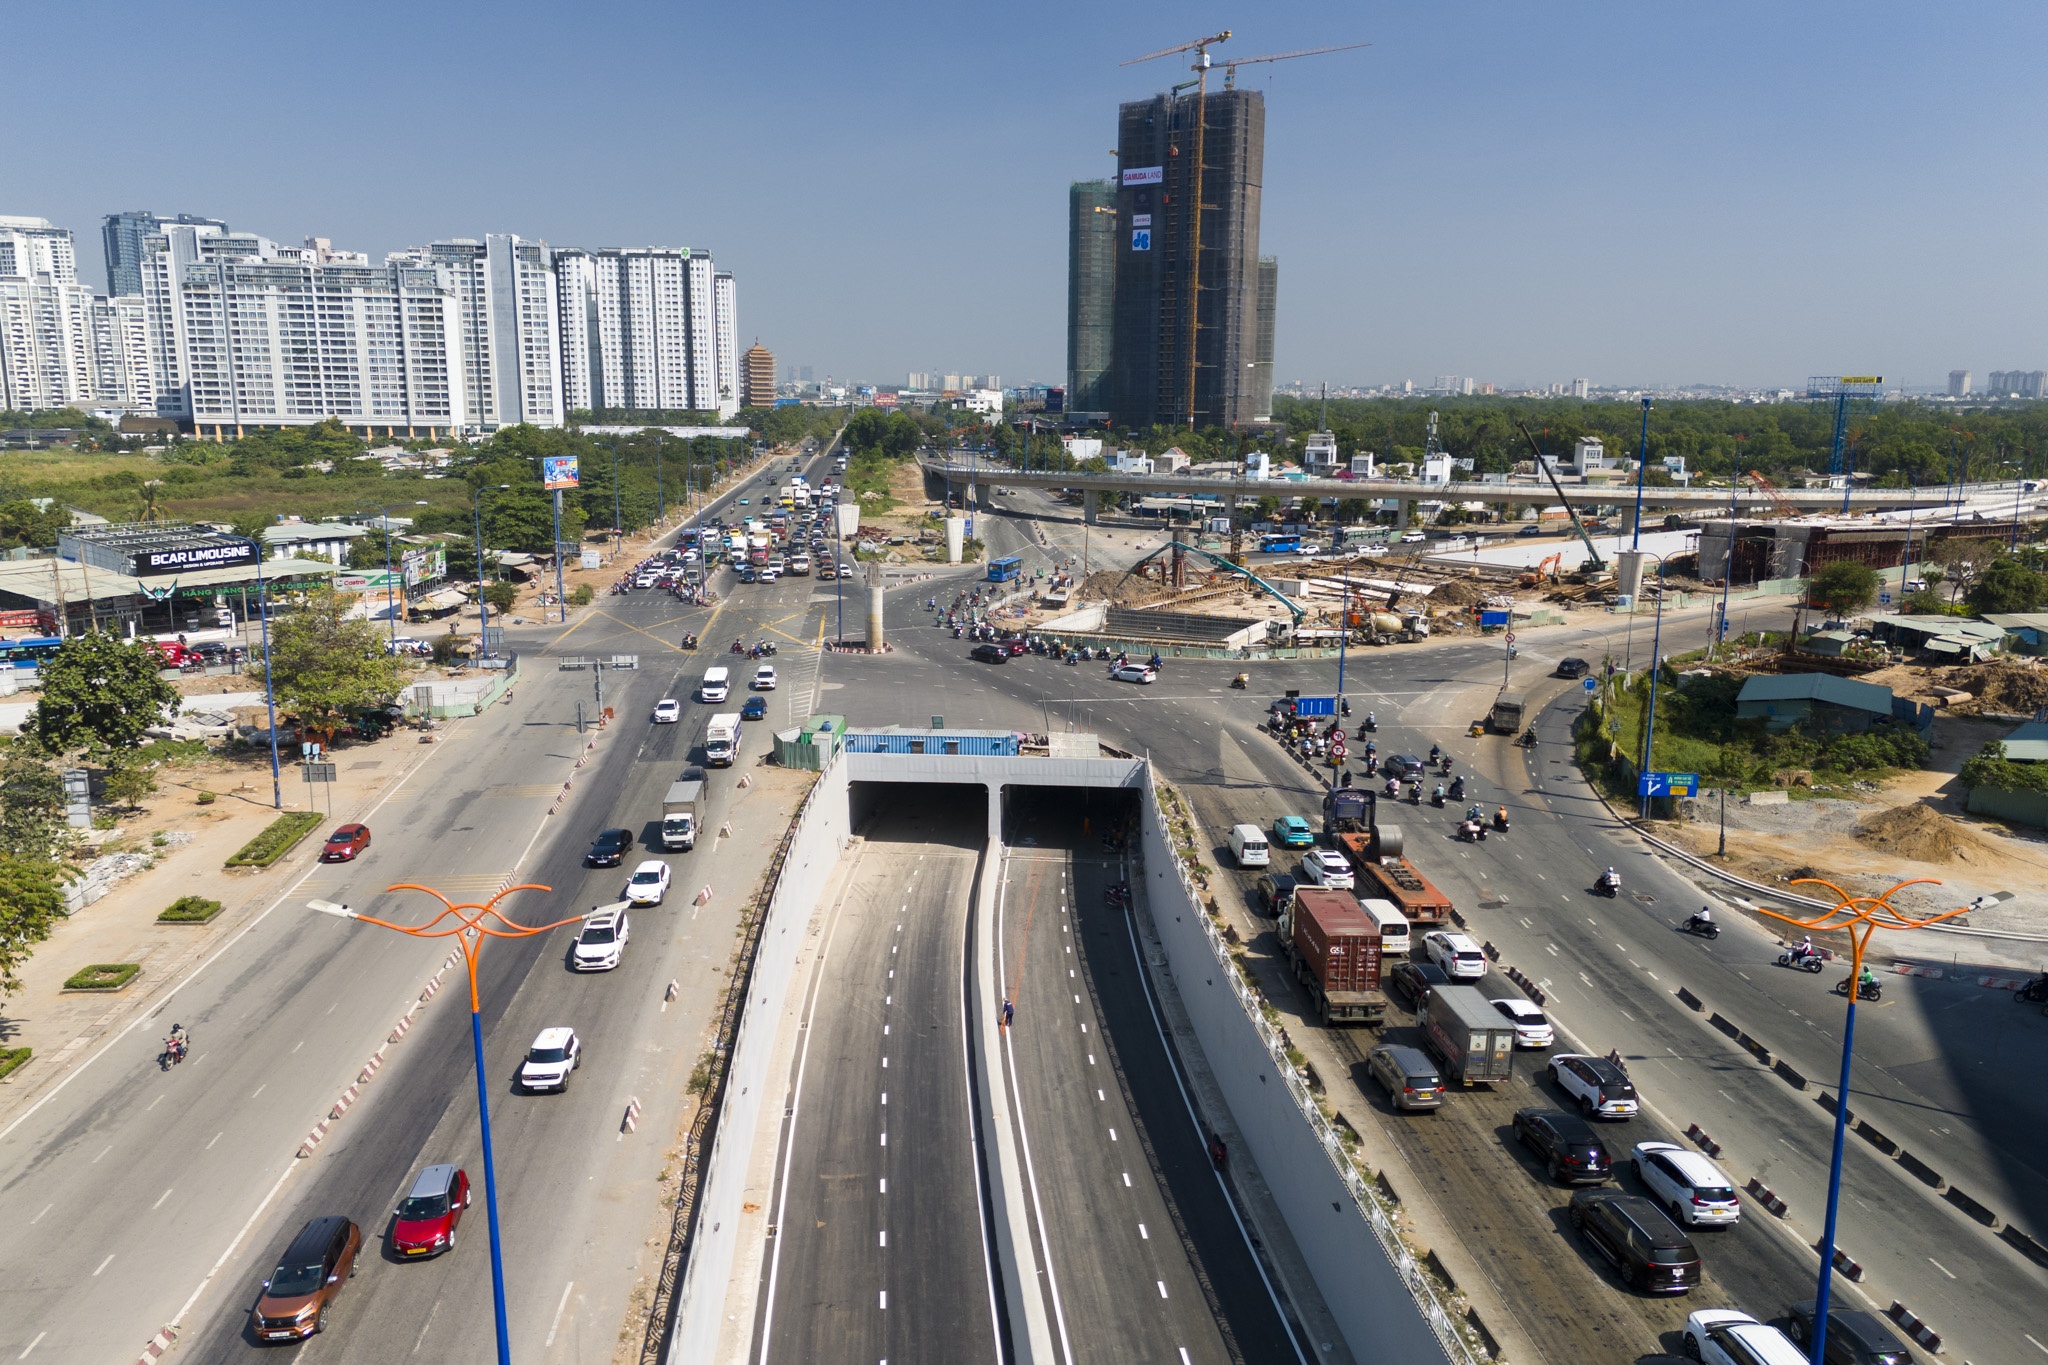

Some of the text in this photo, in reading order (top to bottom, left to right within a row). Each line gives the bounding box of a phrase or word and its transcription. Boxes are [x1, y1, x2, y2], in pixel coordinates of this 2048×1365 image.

[1124, 171, 1161, 181] GAMUDA LAND
[150, 546, 250, 566] BCAR LIMOUSINE
[1330, 946, 1345, 955] GSL
